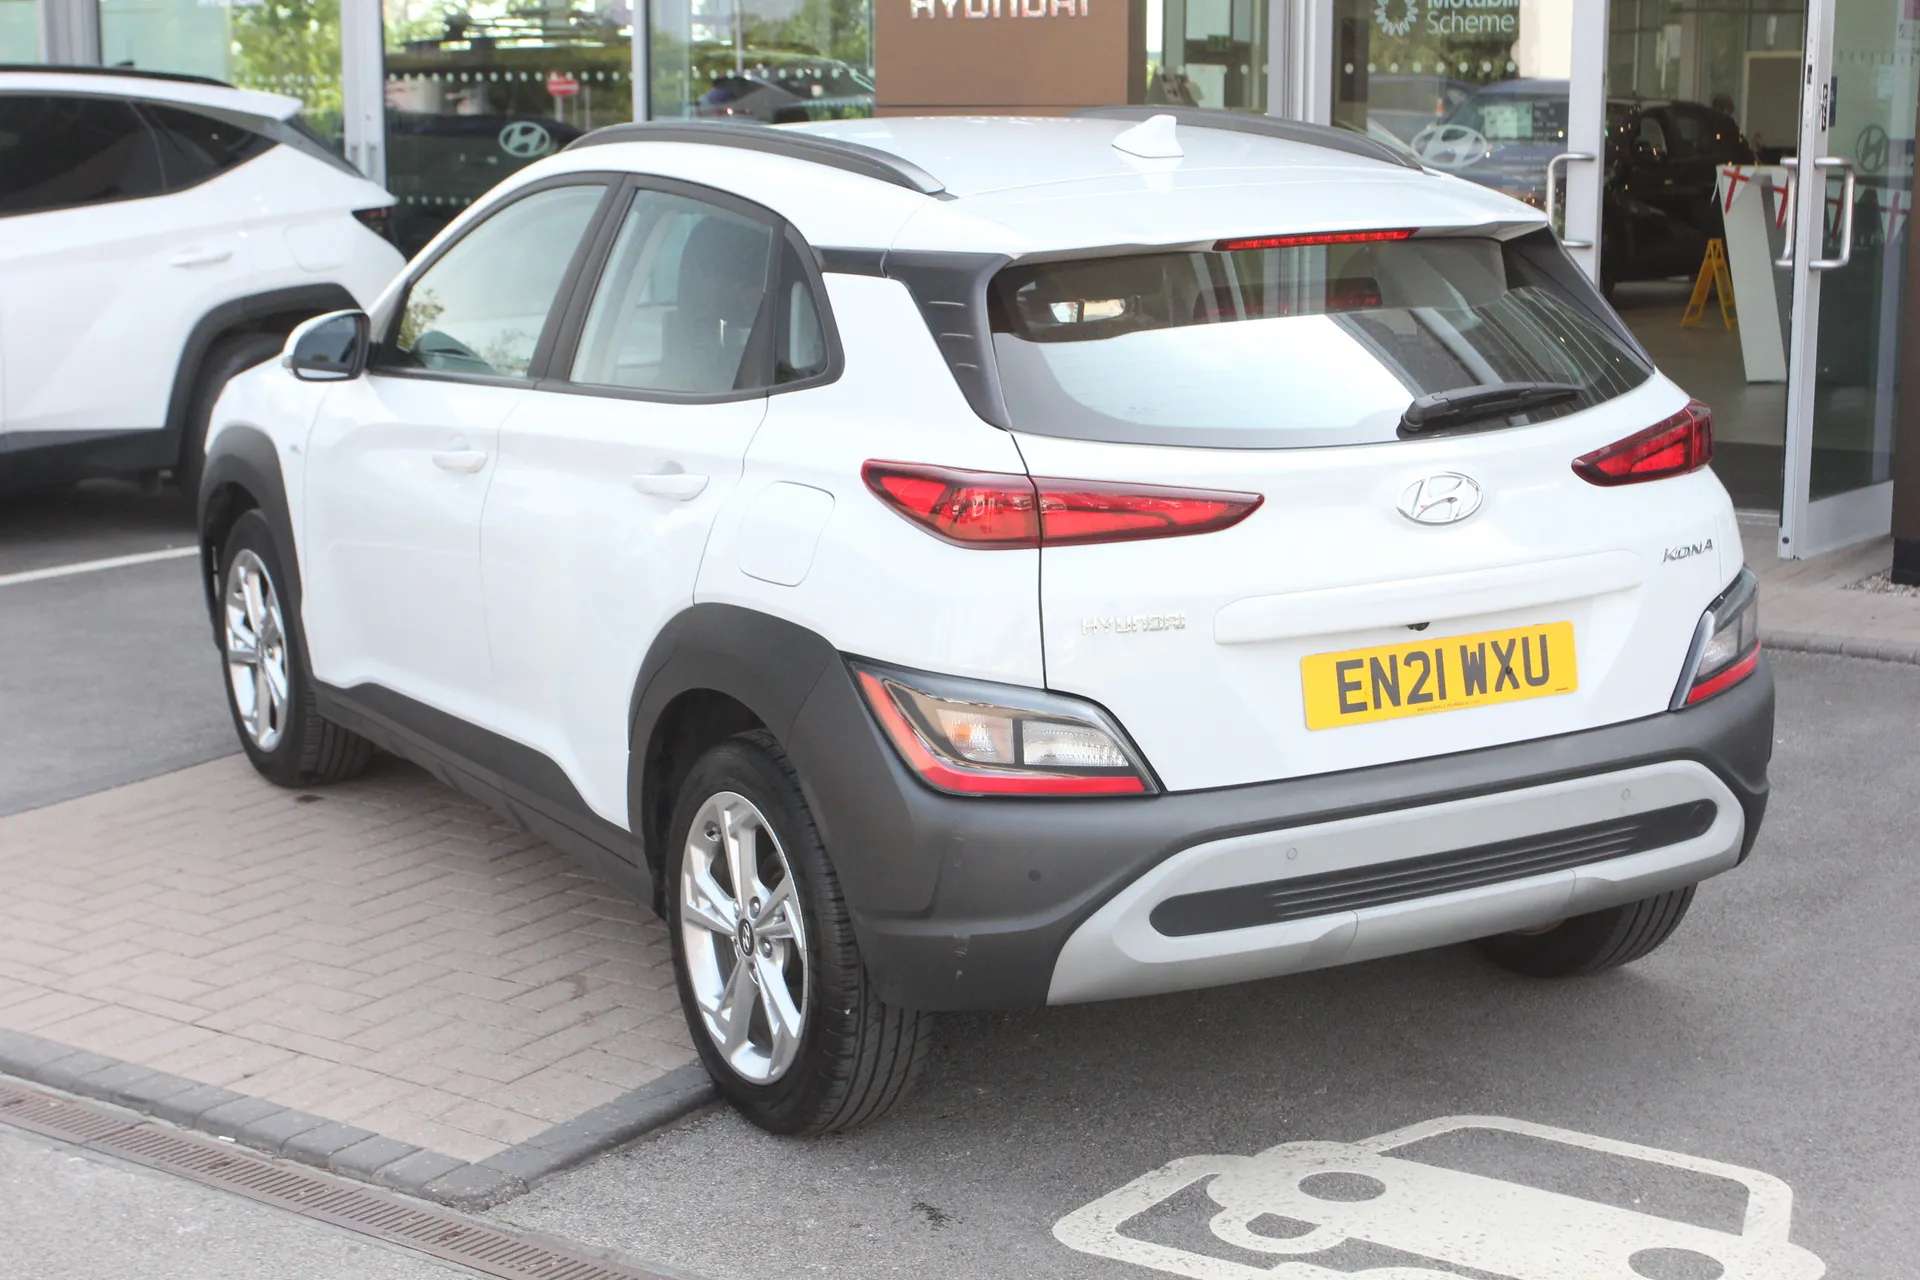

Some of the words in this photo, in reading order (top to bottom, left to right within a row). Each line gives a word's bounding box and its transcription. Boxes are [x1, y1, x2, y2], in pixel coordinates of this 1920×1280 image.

[1426, 11, 1515, 34] Scheme
[1662, 538, 1713, 563] KONA
[1335, 647, 1448, 715] EN21
[1458, 634, 1550, 697] WXU
